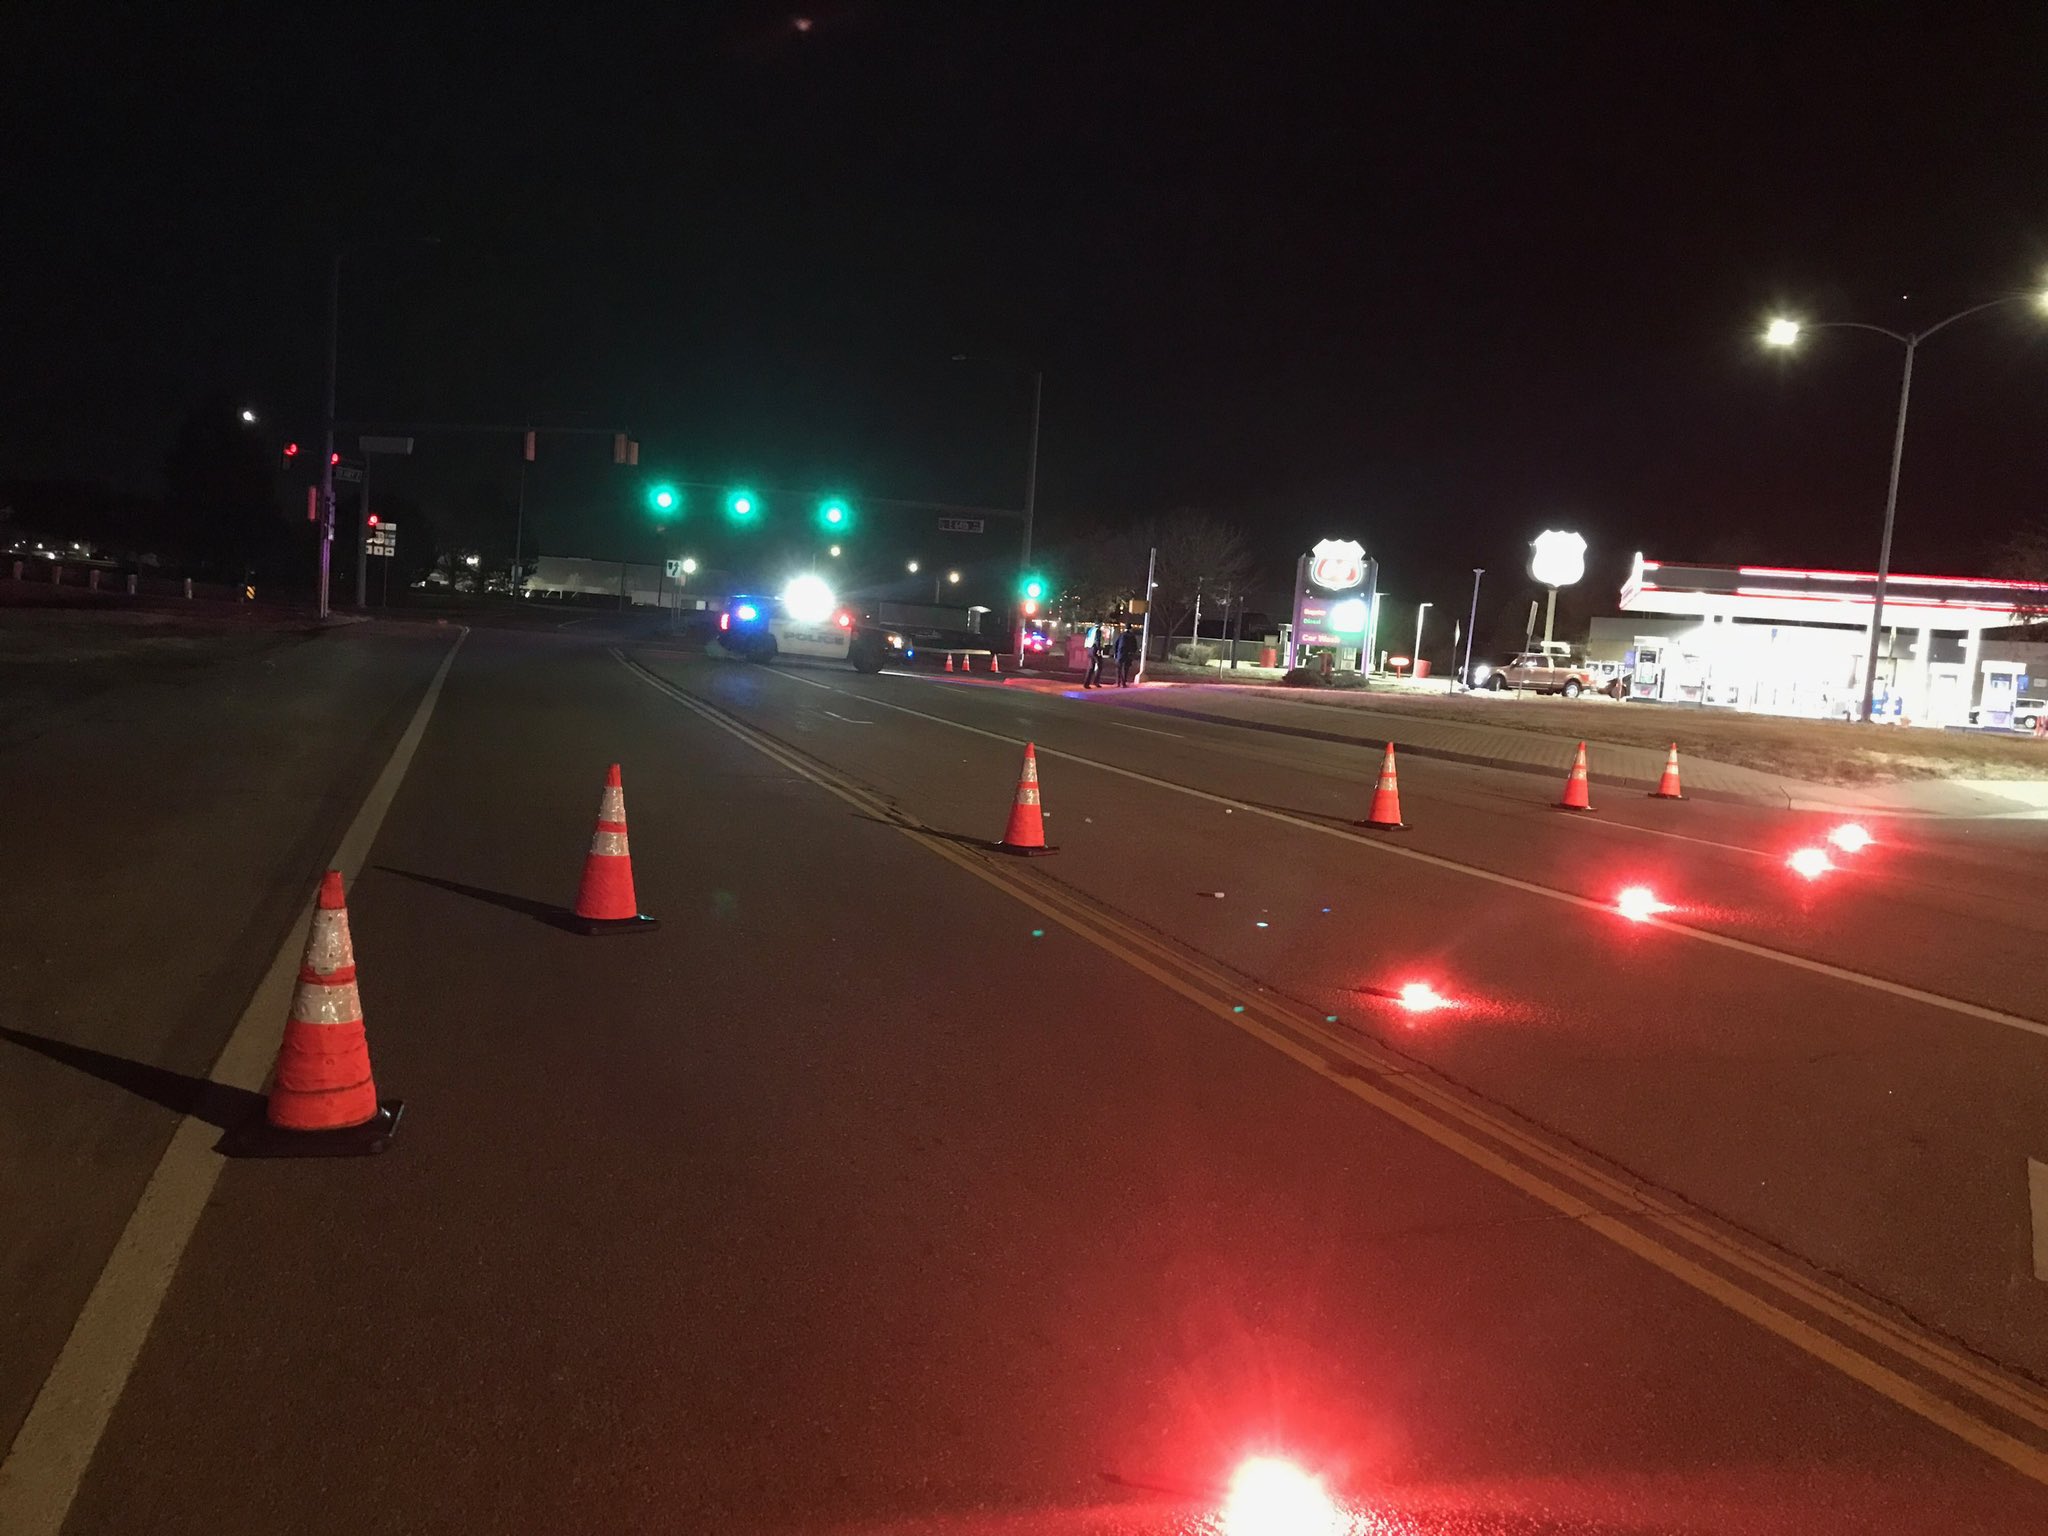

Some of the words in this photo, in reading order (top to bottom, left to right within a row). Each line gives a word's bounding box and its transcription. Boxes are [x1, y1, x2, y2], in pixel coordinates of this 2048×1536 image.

[783, 631, 845, 645] POLICE
[1302, 634, 1317, 642] Car
[1318, 634, 1341, 644] Wash
